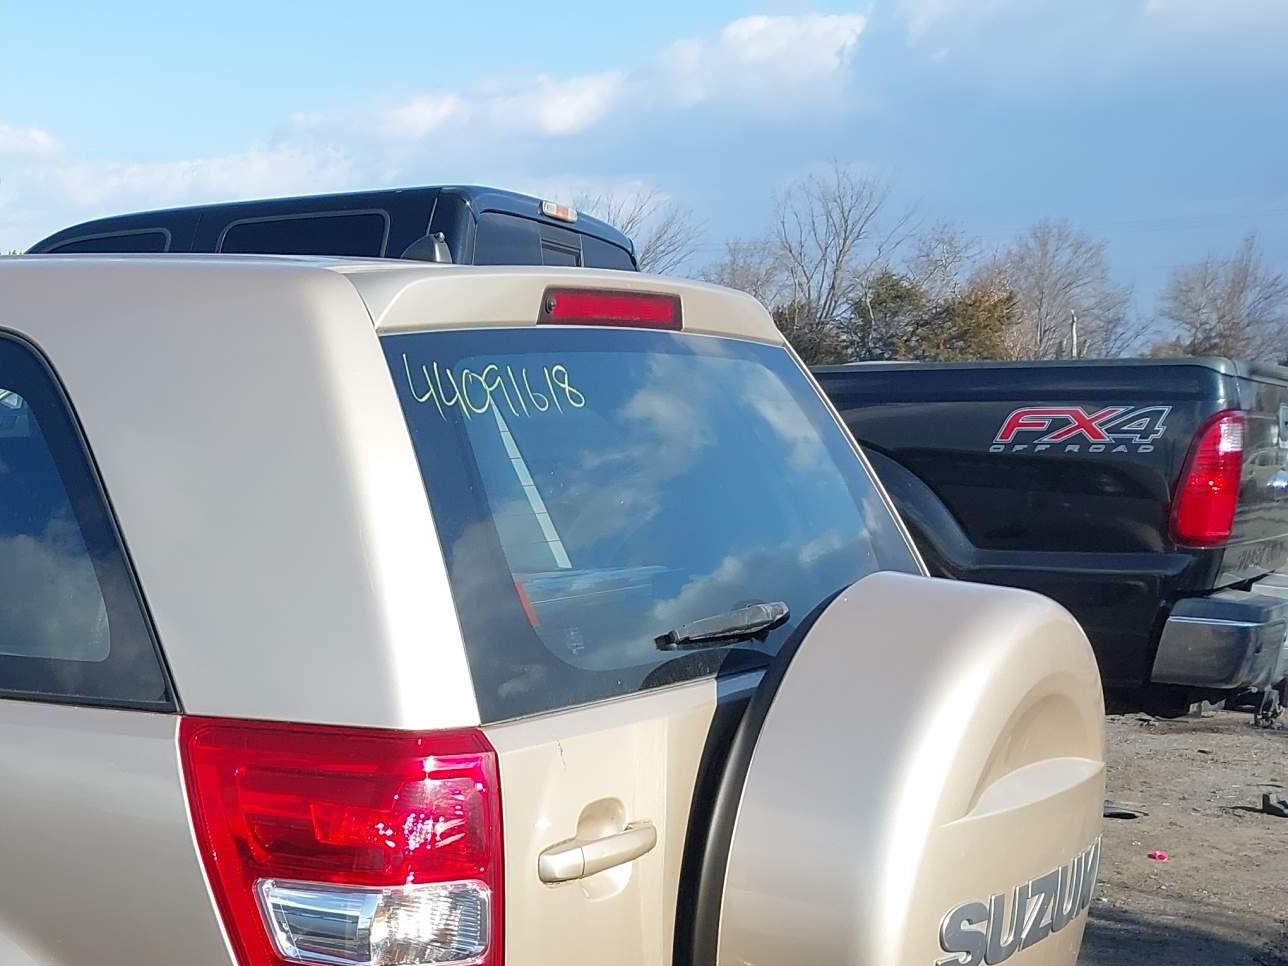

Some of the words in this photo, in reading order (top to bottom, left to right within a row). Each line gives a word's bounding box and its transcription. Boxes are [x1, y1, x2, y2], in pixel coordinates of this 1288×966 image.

[402, 353, 585, 422] 44091618
[993, 406, 1172, 443] FX4
[989, 444, 1050, 453] OFF
[1064, 444, 1154, 453] ROAD
